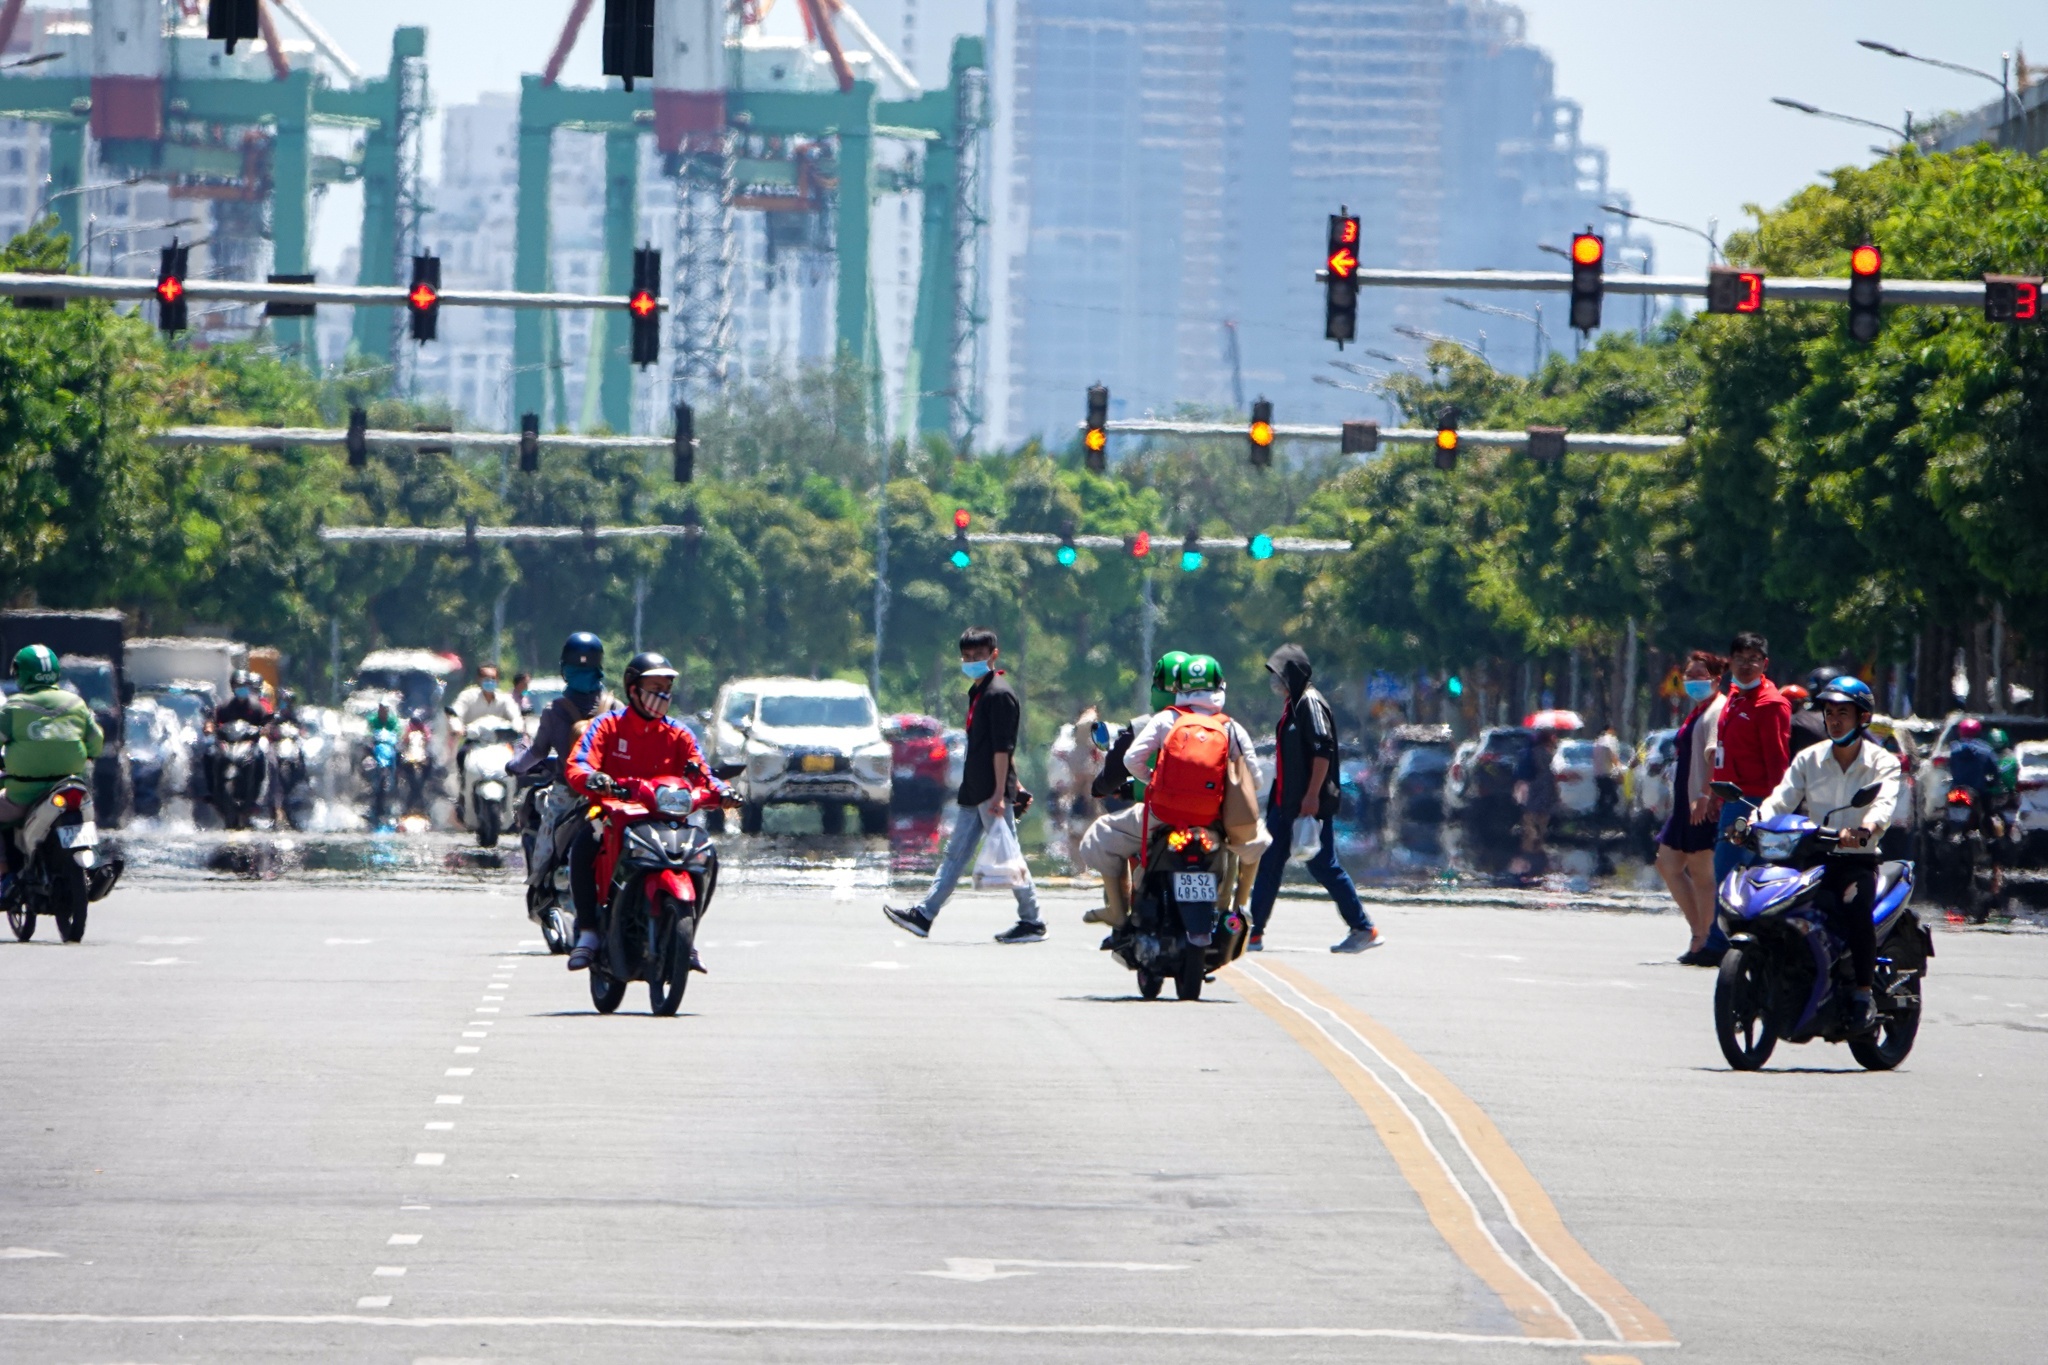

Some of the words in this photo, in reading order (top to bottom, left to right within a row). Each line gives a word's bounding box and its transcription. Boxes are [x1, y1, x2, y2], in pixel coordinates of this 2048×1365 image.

[1342, 219, 1358, 243] 3
[2016, 283, 2036, 319] 3
[34, 672, 57, 682] Grab
